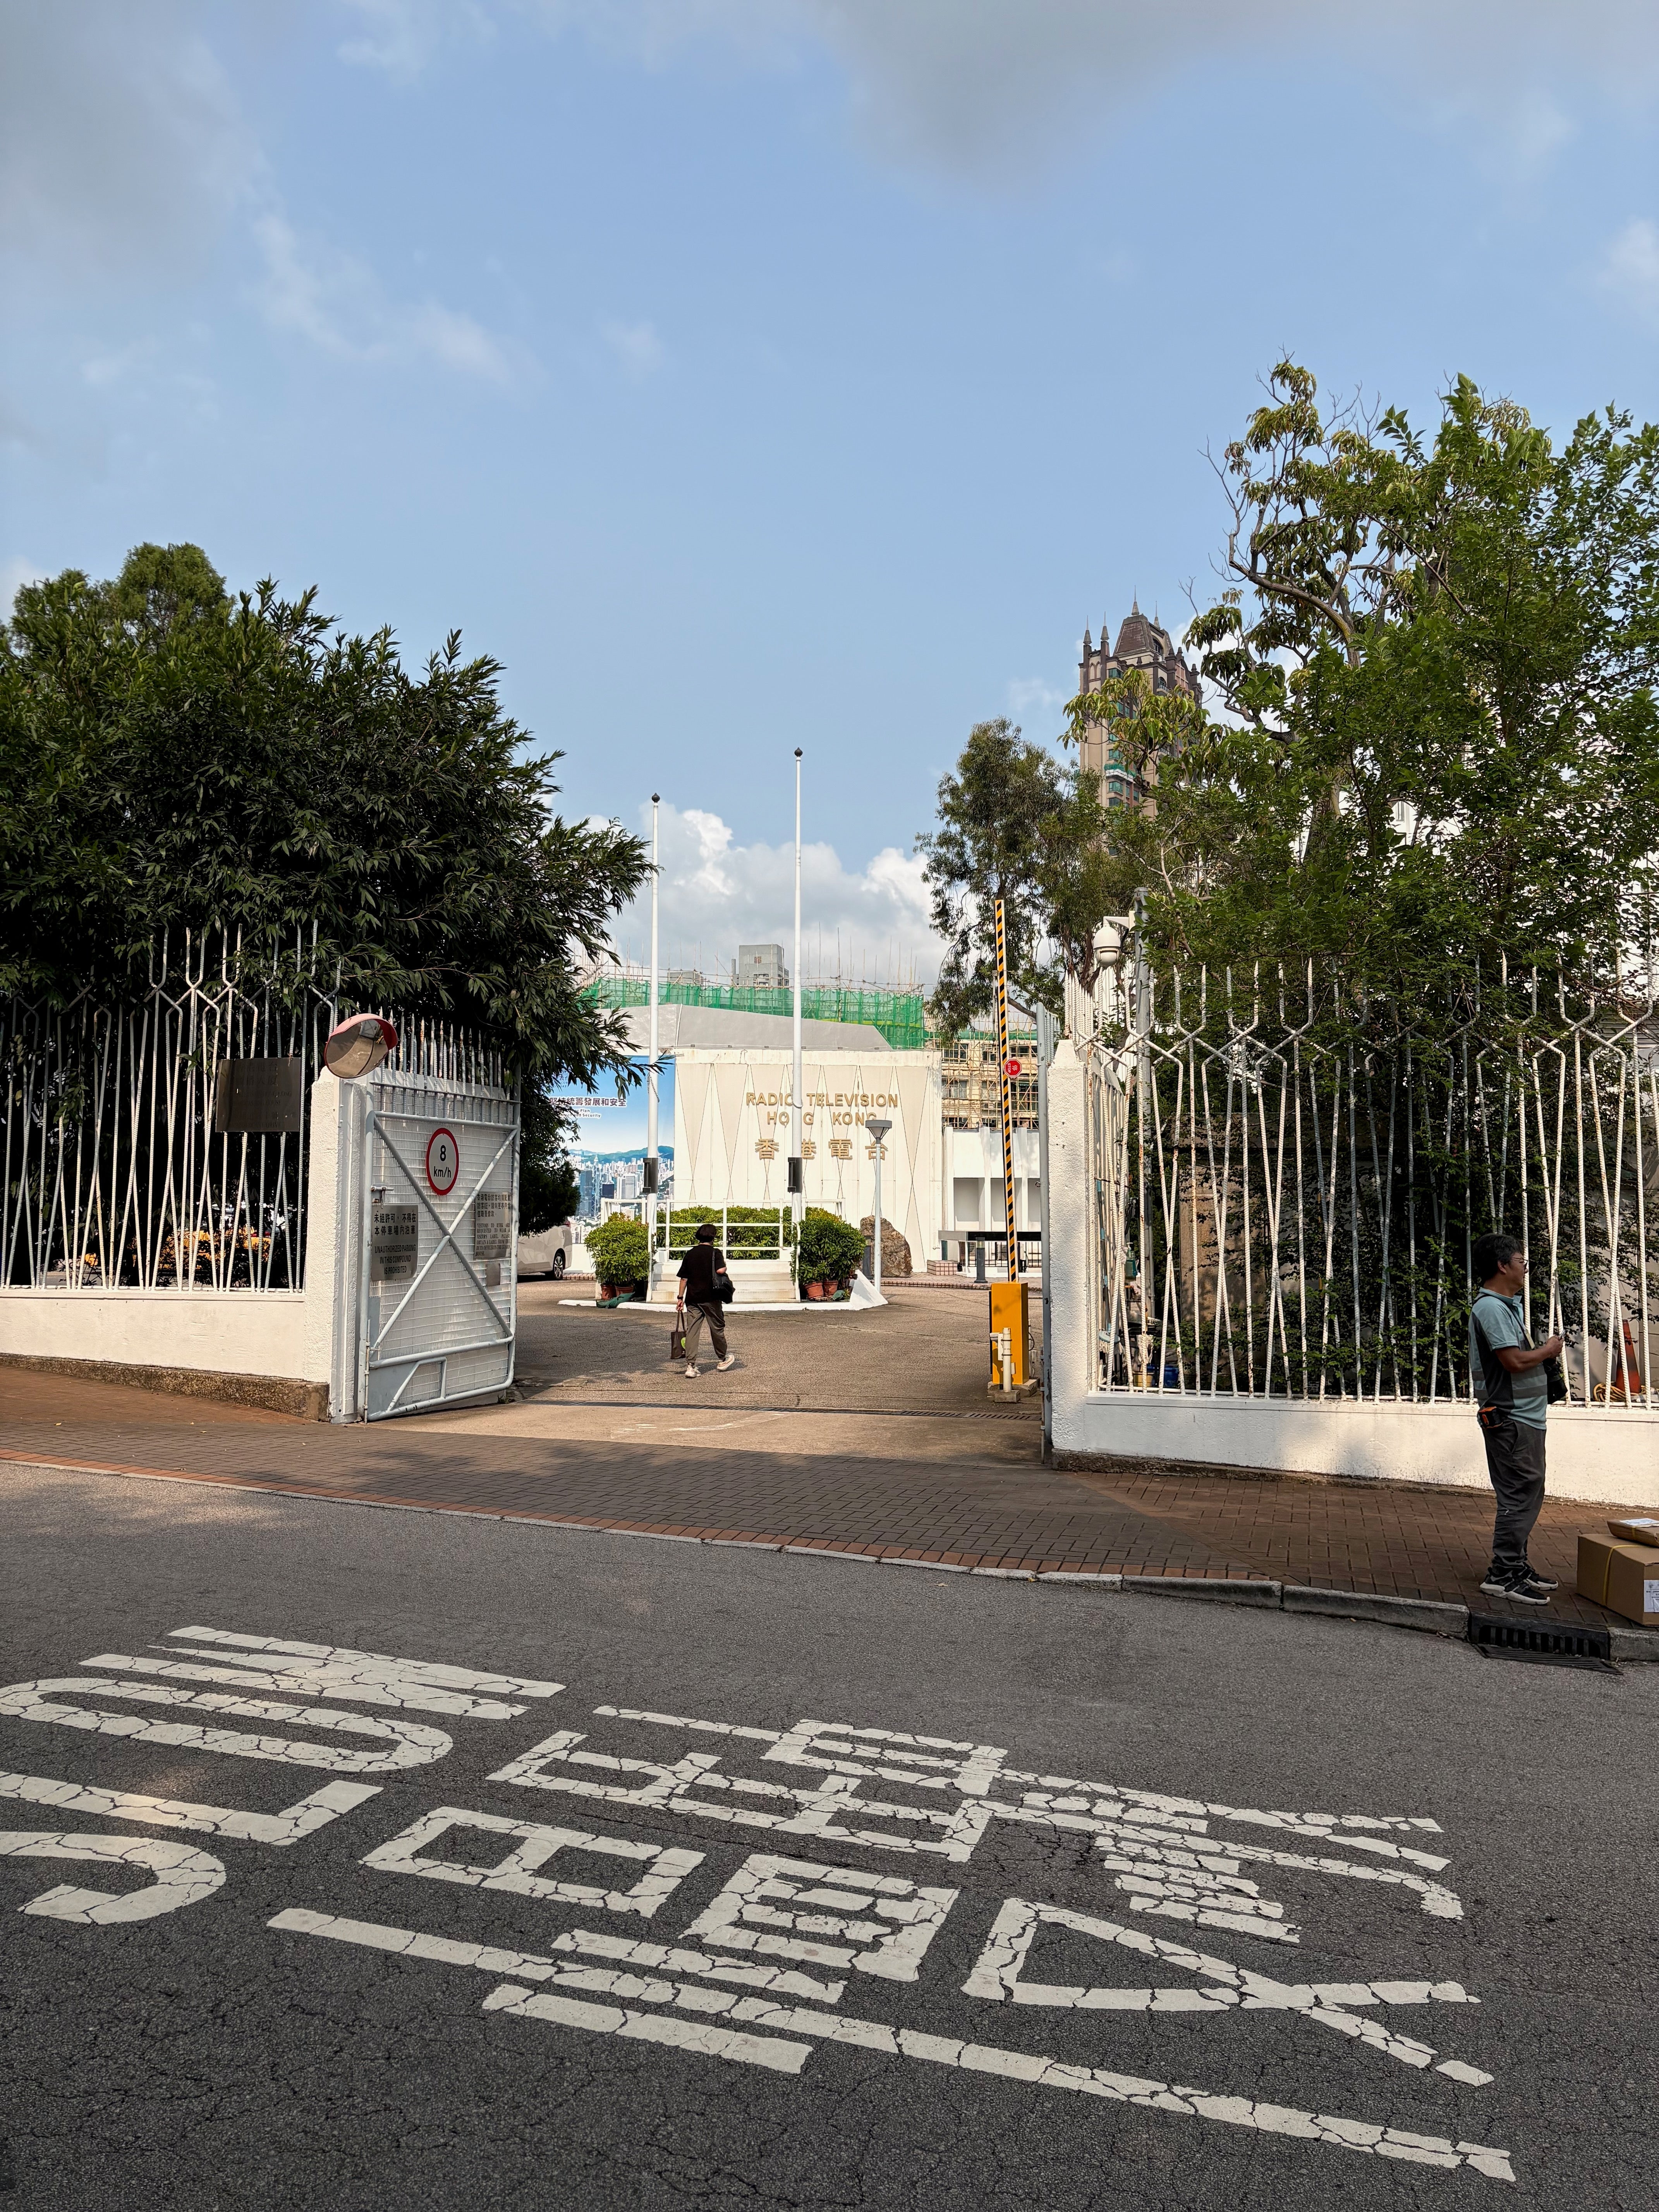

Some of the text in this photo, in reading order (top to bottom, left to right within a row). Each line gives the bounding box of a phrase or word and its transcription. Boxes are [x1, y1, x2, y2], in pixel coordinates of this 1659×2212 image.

[746, 1092, 898, 1107] RADIO TELEVISION
[767, 1111, 814, 1127] HOG
[440, 1145, 446, 1161] 8
[434, 1166, 451, 1178] km/h
[374, 1224, 416, 1236] 本停車場內泊車
[375, 1245, 402, 1253] UNAUTHORIZED
[392, 1255, 411, 1263] COMPOUND
[267, 1705, 1517, 2185] 慢駛
